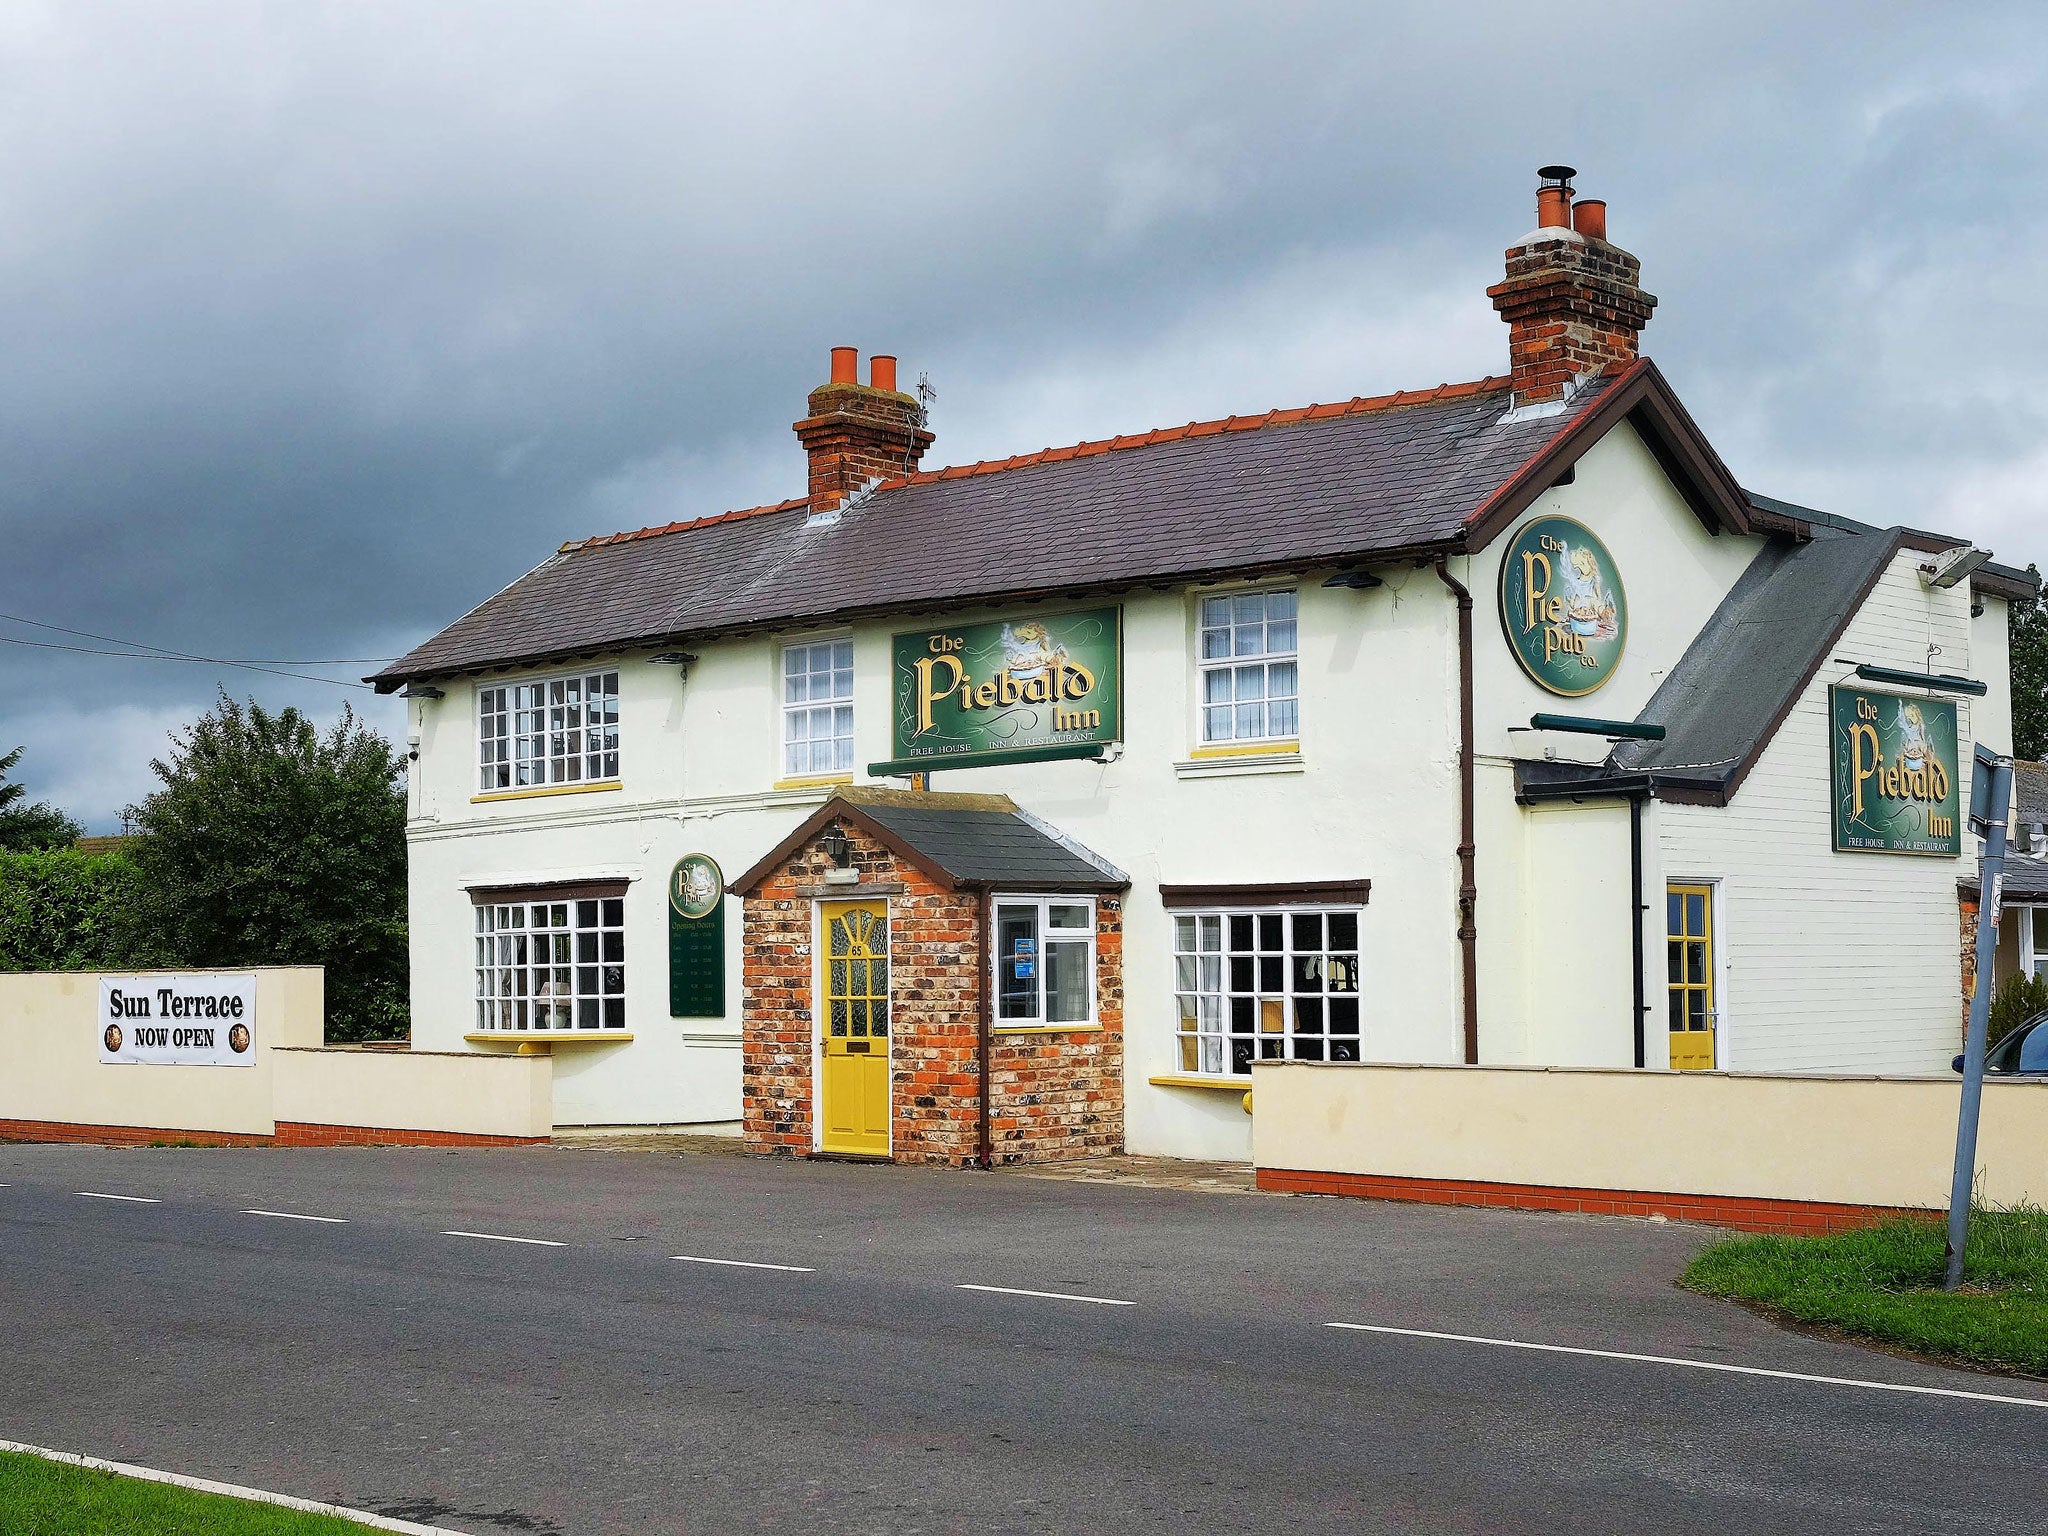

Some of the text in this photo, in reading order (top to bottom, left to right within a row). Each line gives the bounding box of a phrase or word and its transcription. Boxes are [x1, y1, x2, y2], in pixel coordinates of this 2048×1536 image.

[1539, 534, 1563, 552] The
[1521, 550, 1563, 635] Pie
[928, 634, 964, 653] The
[1543, 626, 1586, 666] Pub
[911, 654, 1095, 739] Piebald
[1856, 696, 1878, 720] The
[1053, 706, 1101, 732] Inn
[910, 732, 1096, 756] FREE HOUSE INN & RESTAURANT
[1848, 722, 1949, 824] Piebald
[1927, 808, 1952, 839] Inn
[1848, 837, 1950, 852] FREE HOUSE INN & RESTAURANT
[852, 946, 862, 956] 65
[110, 988, 243, 1018] Sun Terrace
[134, 1027, 169, 1047] NOW
[172, 1027, 215, 1047] OPEN
